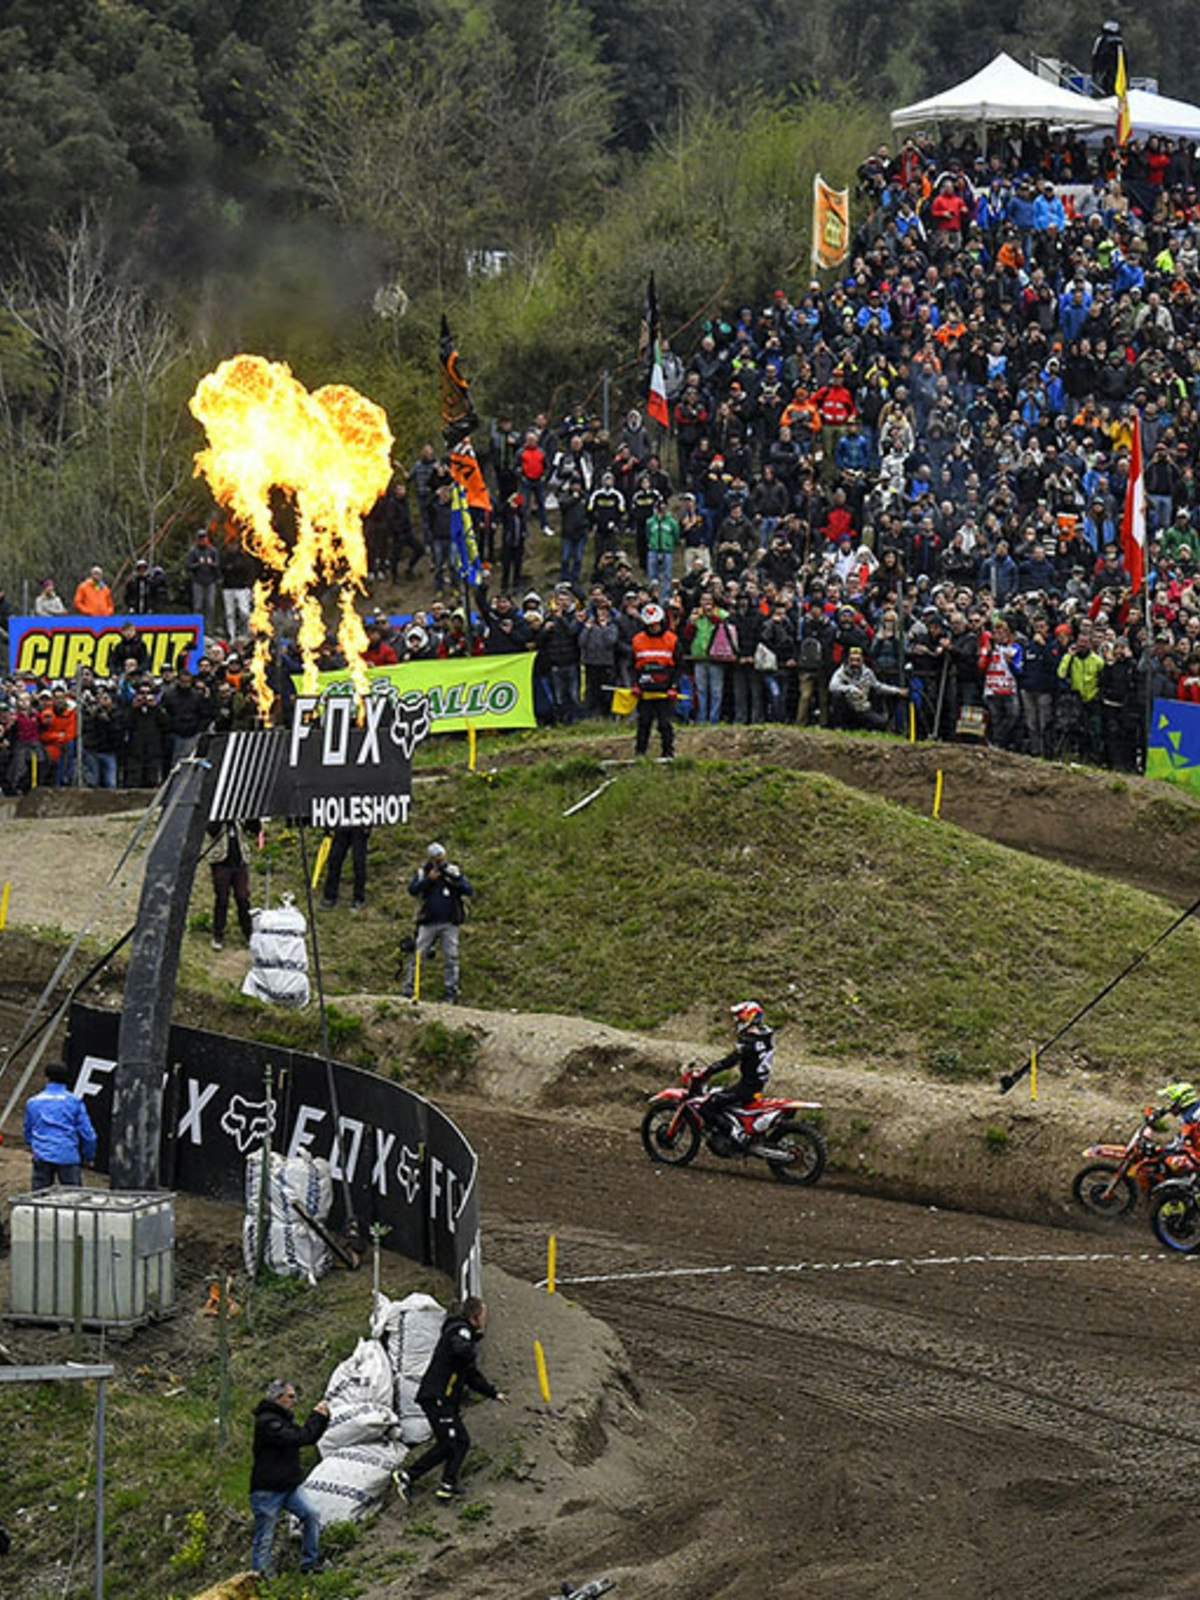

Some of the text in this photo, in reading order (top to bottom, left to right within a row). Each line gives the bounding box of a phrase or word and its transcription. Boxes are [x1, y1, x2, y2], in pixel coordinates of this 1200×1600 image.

[18, 632, 194, 679] CIRCIT
[289, 697, 387, 767] FOX
[312, 795, 410, 828] HOLESHOT
[73, 1055, 220, 1146] FX
[287, 1105, 396, 1195] FOX
